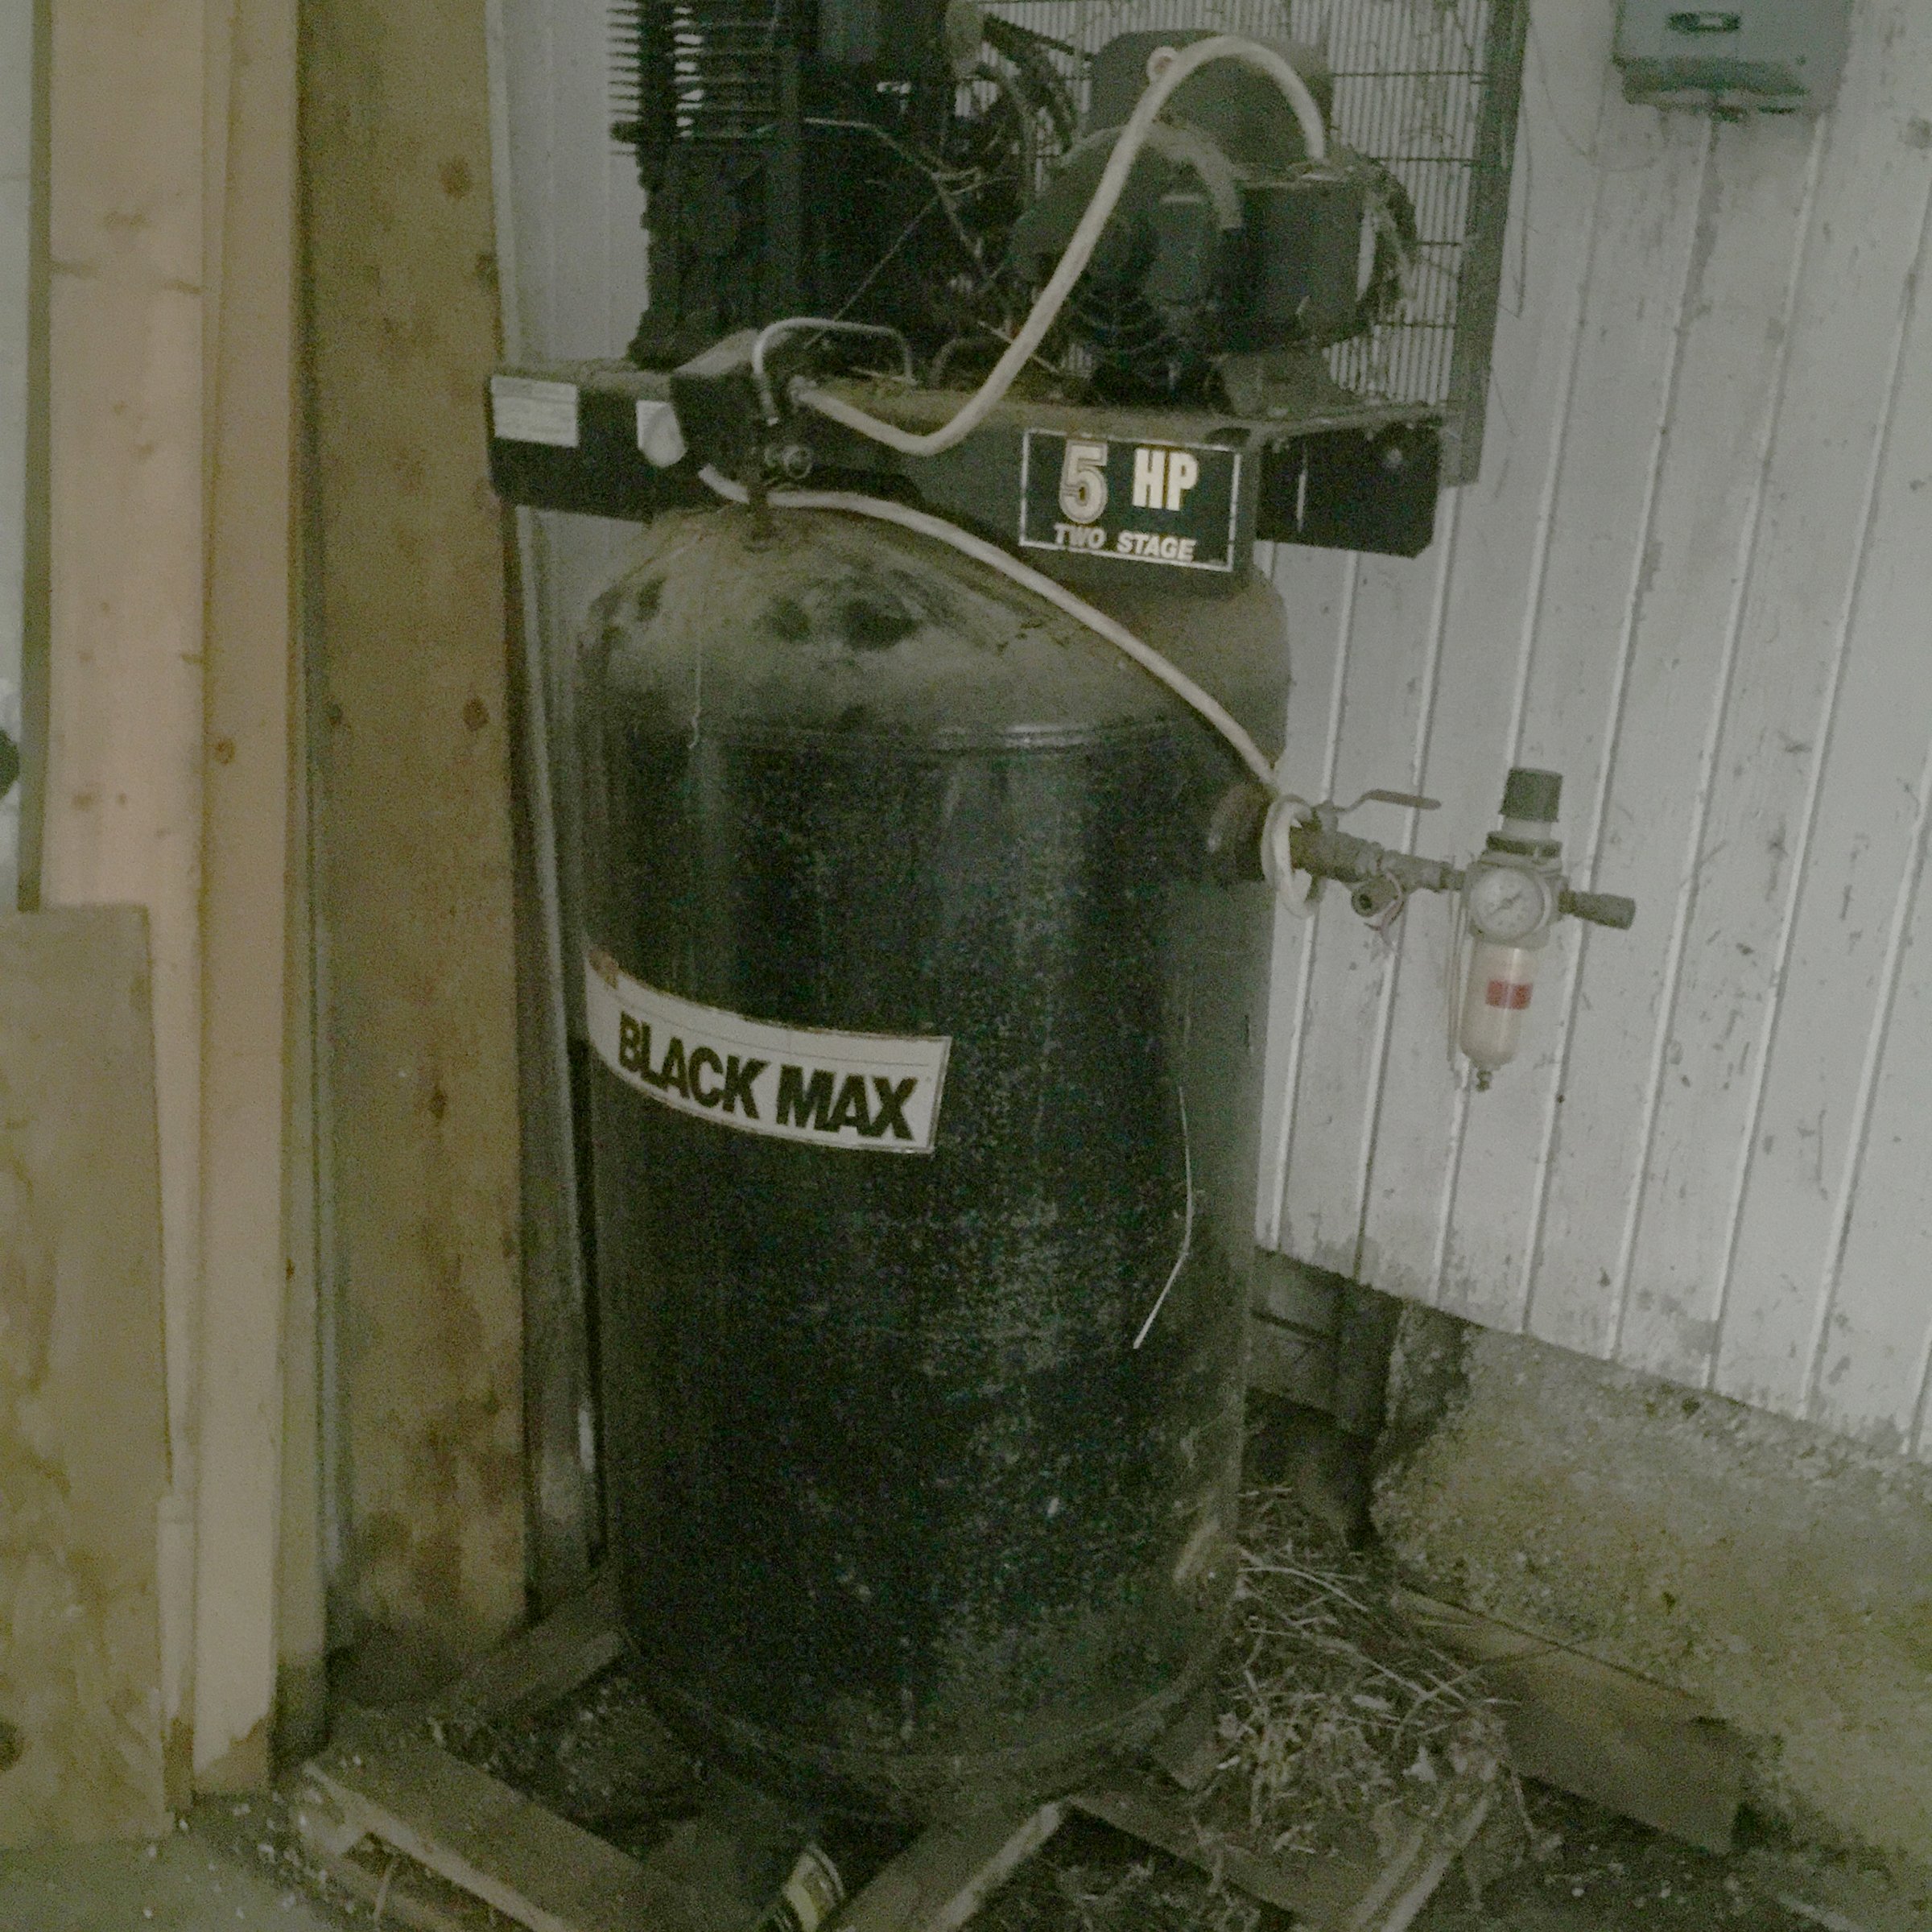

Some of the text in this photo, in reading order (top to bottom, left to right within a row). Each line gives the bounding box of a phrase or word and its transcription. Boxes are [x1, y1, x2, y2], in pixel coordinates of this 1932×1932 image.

[1059, 440, 1199, 524] 5 HP
[1053, 522, 1198, 562] TWO STAGE
[619, 1011, 919, 1141] BLACK MAX
